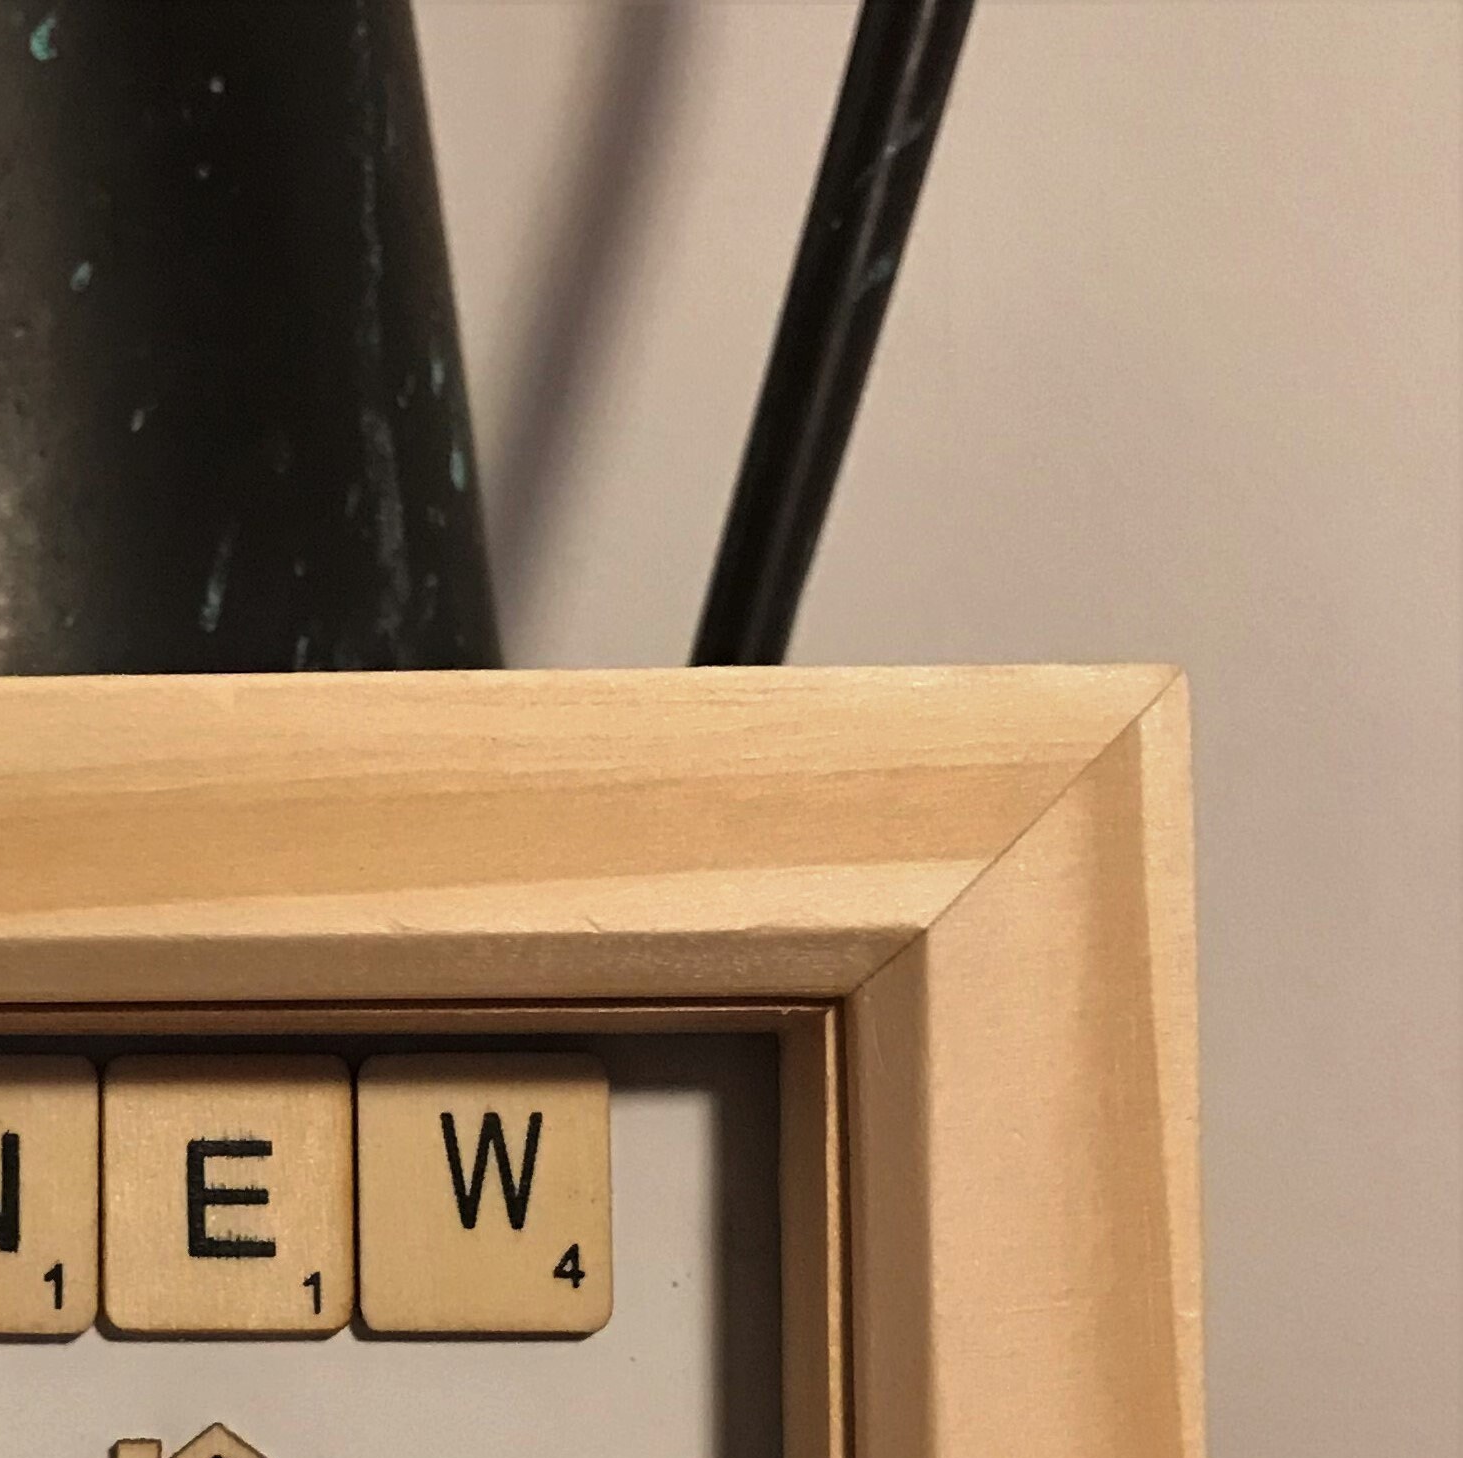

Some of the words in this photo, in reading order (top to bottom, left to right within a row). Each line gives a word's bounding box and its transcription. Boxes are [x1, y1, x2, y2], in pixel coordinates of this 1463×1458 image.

[43, 1262, 65, 1310] 1
[552, 1243, 586, 1289] 4
[302, 1270, 323, 1315] 1
